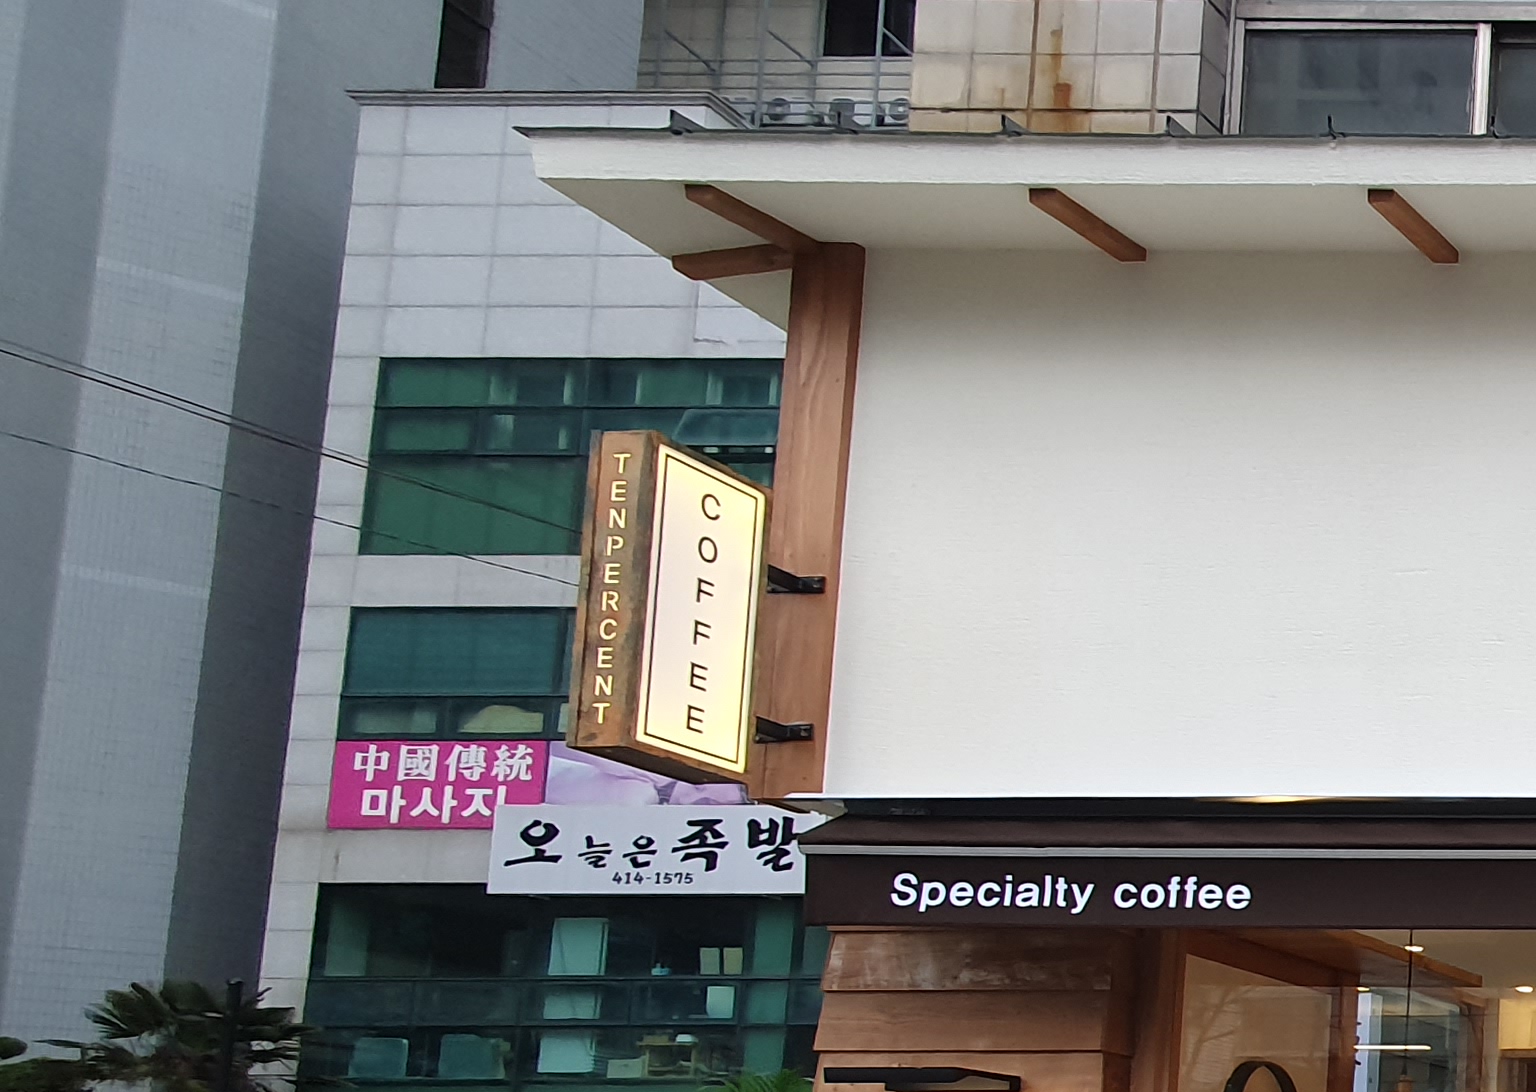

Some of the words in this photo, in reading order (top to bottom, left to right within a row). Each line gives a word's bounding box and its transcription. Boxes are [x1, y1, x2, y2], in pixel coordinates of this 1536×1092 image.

[591, 452, 632, 725] TENPERCENT
[685, 493, 722, 735] COFFEE
[353, 744, 534, 782] 中國傳統
[611, 871, 694, 885] 414-1575
[890, 872, 1095, 914] Specialty
[1113, 875, 1252, 910] coffee
